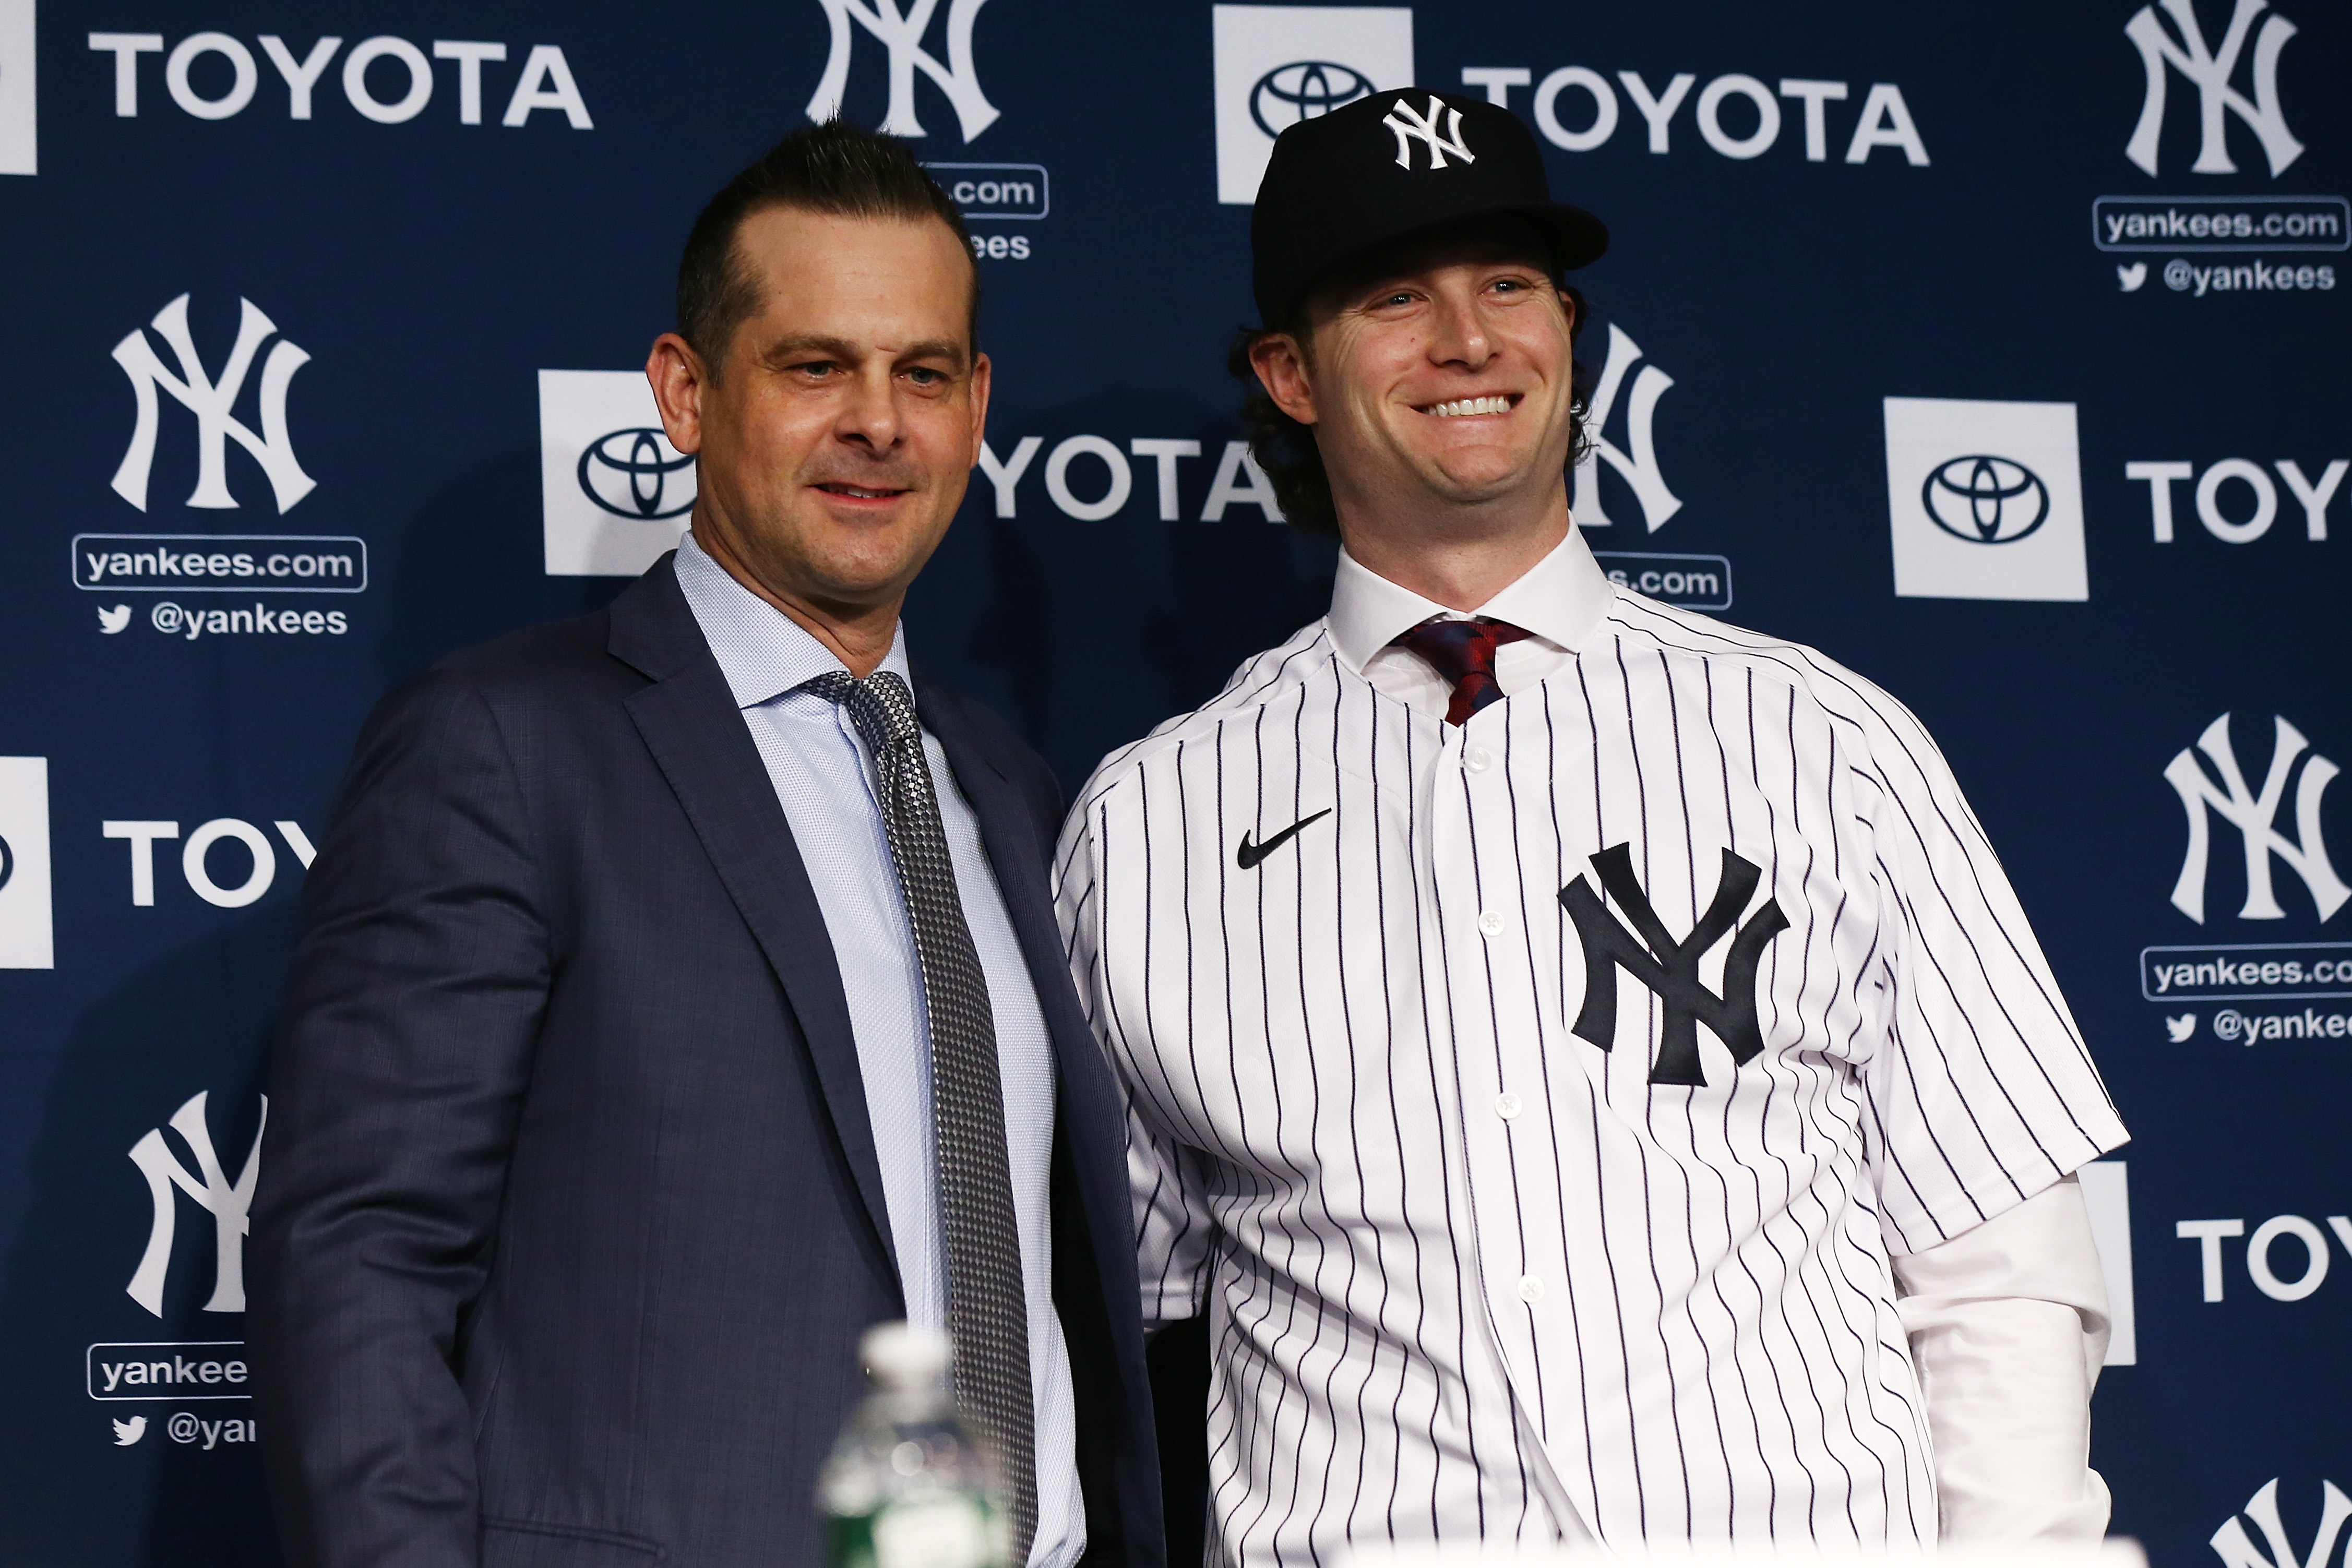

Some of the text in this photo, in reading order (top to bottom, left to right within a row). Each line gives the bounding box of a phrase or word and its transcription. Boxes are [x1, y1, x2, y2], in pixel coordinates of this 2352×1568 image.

[88, 32, 594, 129] TOYOTA
[805, 0, 1001, 145] NY
[2123, 0, 2306, 179] NY
[1383, 95, 1475, 171] NY
[1462, 66, 1931, 166] TOYOTA
[2105, 208, 2339, 243] yankees.com
[2164, 258, 2336, 297] @yankees
[111, 293, 318, 515] NY
[977, 434, 1288, 523] YOTA
[87, 547, 353, 582] yankees.com
[151, 602, 348, 640] @yankees
[2163, 711, 2352, 925] NY
[1557, 841, 1790, 1087] NY
[2154, 957, 2352, 993] yankees.co
[2213, 1008, 2352, 1047] @yanke
[101, 1355, 248, 1392] yankee
